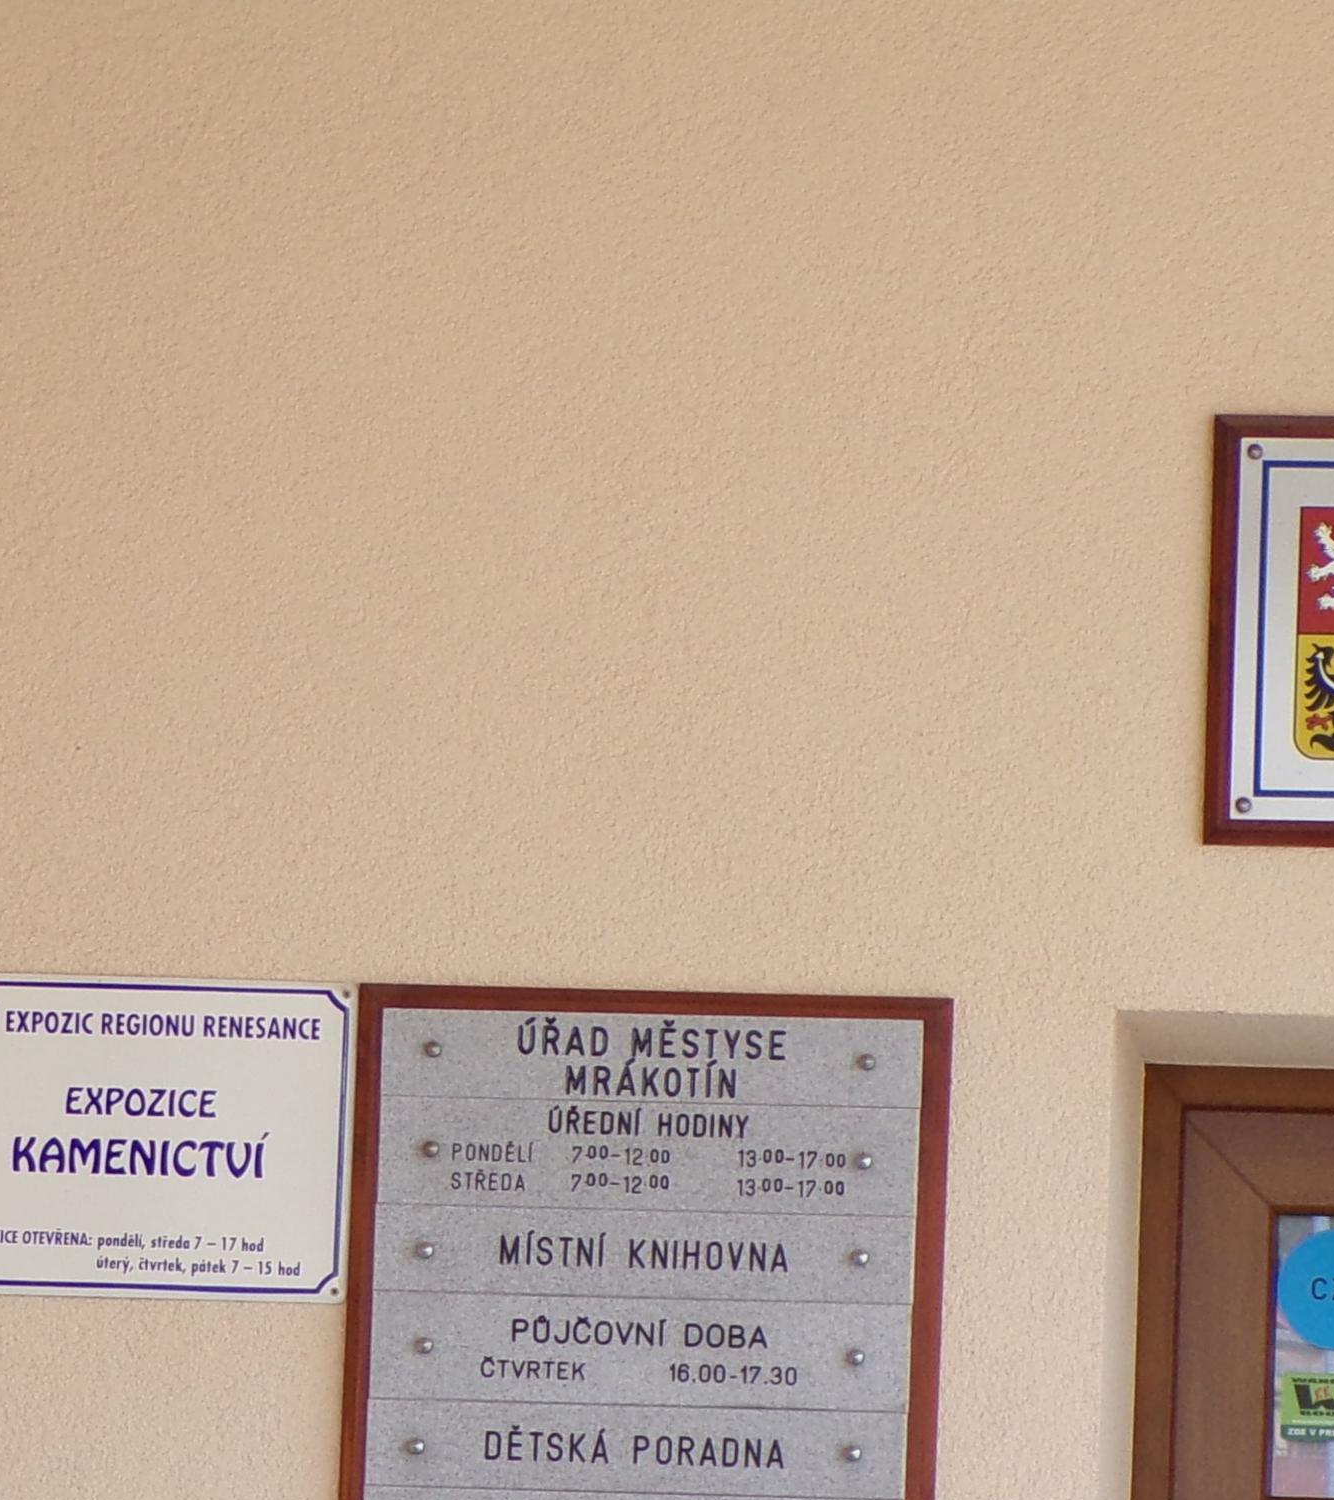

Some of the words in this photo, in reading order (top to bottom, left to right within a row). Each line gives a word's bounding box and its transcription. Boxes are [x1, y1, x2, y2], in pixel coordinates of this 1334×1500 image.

[4, 1008, 94, 1037] EXPOZIC
[100, 1011, 196, 1039] REGIONU
[202, 1014, 322, 1041] RENESANCE
[516, 1016, 611, 1059] ÚŘAD
[631, 1019, 788, 1062] MĚSTYSE
[564, 1057, 739, 1100] MRÁKOTÍN
[64, 1085, 218, 1120] EXPOZICE
[547, 1104, 642, 1137] ÚŘEDNÍ
[656, 1110, 751, 1140] HODINY
[10, 1131, 271, 1180] KAMENICTVÍ
[450, 1140, 534, 1164] PONDĚLÍ
[449, 1168, 527, 1193] STŘEDA
[21, 1227, 93, 1249] OTEVŘENA:
[96, 1232, 148, 1251] pondělí,
[149, 1234, 191, 1251] středa
[193, 1235, 203, 1251] 7
[220, 1236, 237, 1253] 17
[240, 1236, 265, 1254] hod
[497, 1230, 607, 1270] MÍSTNÍ
[627, 1238, 790, 1275] KNIHOVNA
[95, 1256, 135, 1276] úterý,
[138, 1256, 188, 1276] čtvrtek,
[190, 1258, 227, 1277] pátek
[230, 1260, 240, 1275] 7
[257, 1260, 273, 1276] 15
[277, 1261, 302, 1277] hod
[510, 1315, 668, 1349] PŮJČOVNÍ
[683, 1323, 769, 1351] DOBA
[479, 1355, 587, 1382] ČTVRTEK
[668, 1363, 799, 1387] 16.00-17.30
[483, 1424, 610, 1466] DĚTSKÁ
[631, 1434, 786, 1471] PORADNA
